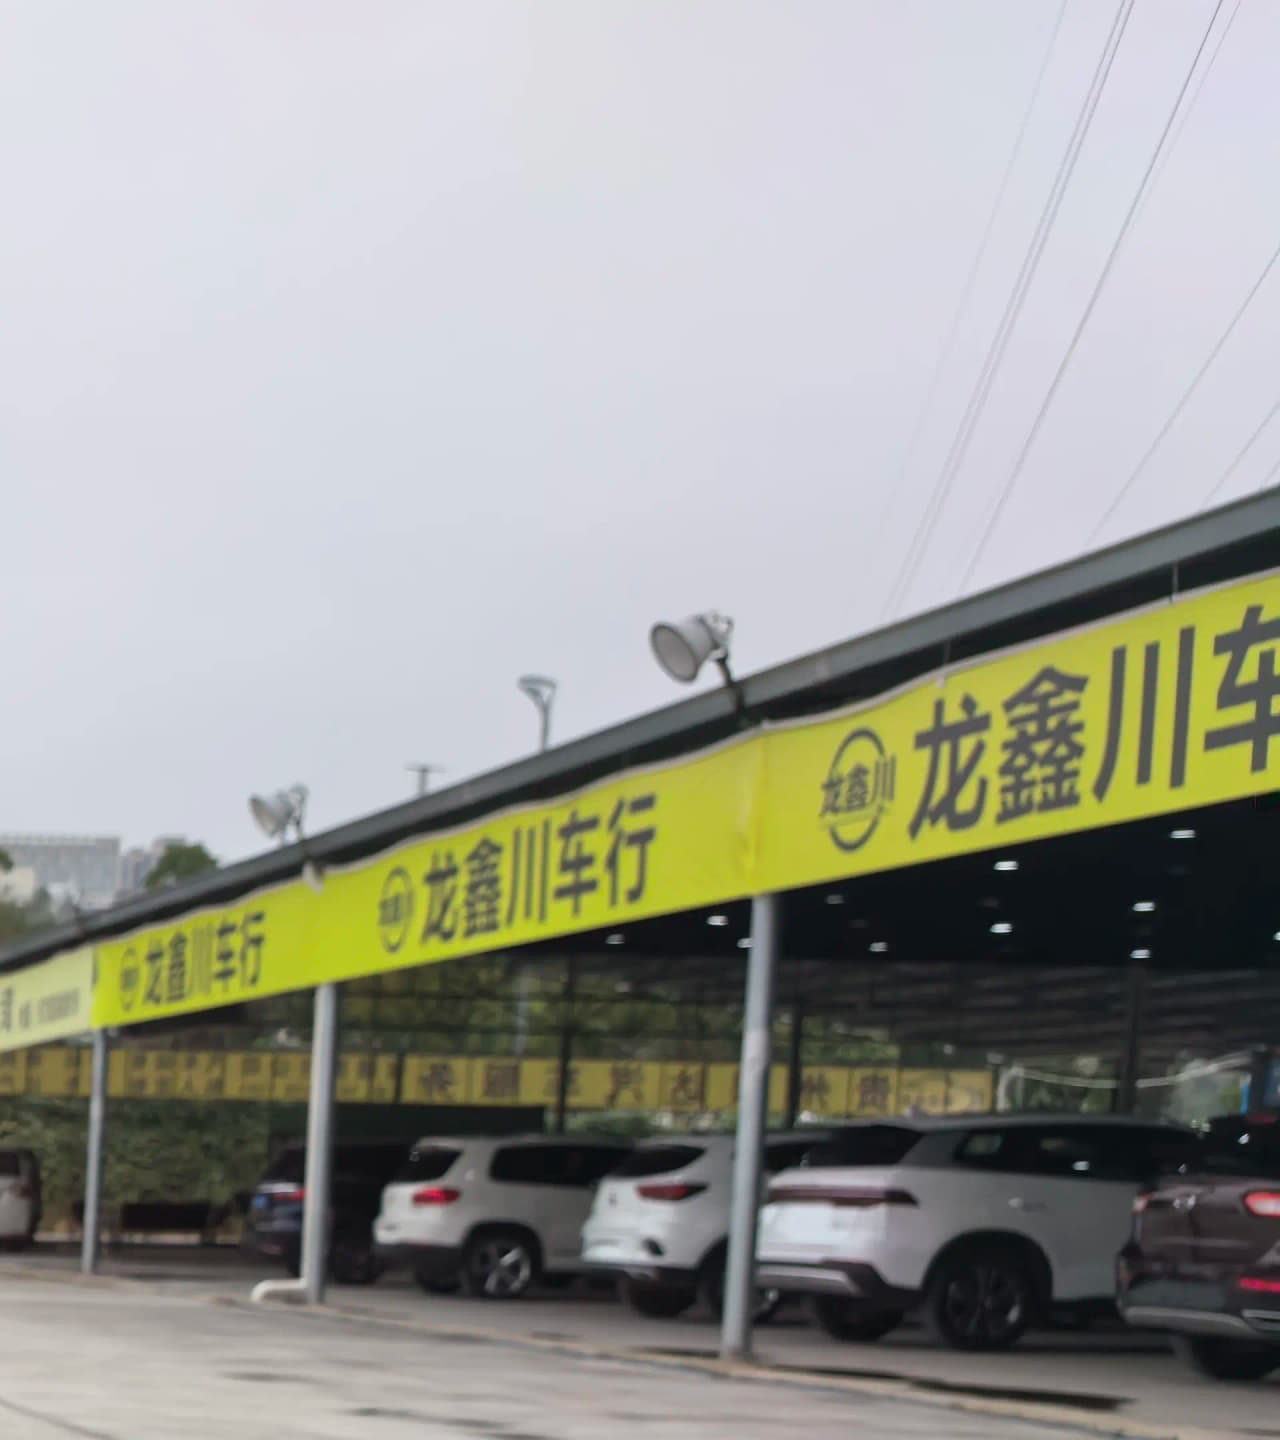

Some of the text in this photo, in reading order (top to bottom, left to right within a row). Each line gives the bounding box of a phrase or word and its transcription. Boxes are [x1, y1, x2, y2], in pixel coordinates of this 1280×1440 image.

[819, 755, 896, 818] 龙鑫川
[420, 794, 656, 945] 龙鑫川车行
[143, 911, 265, 1004] 龙鑫川车行
